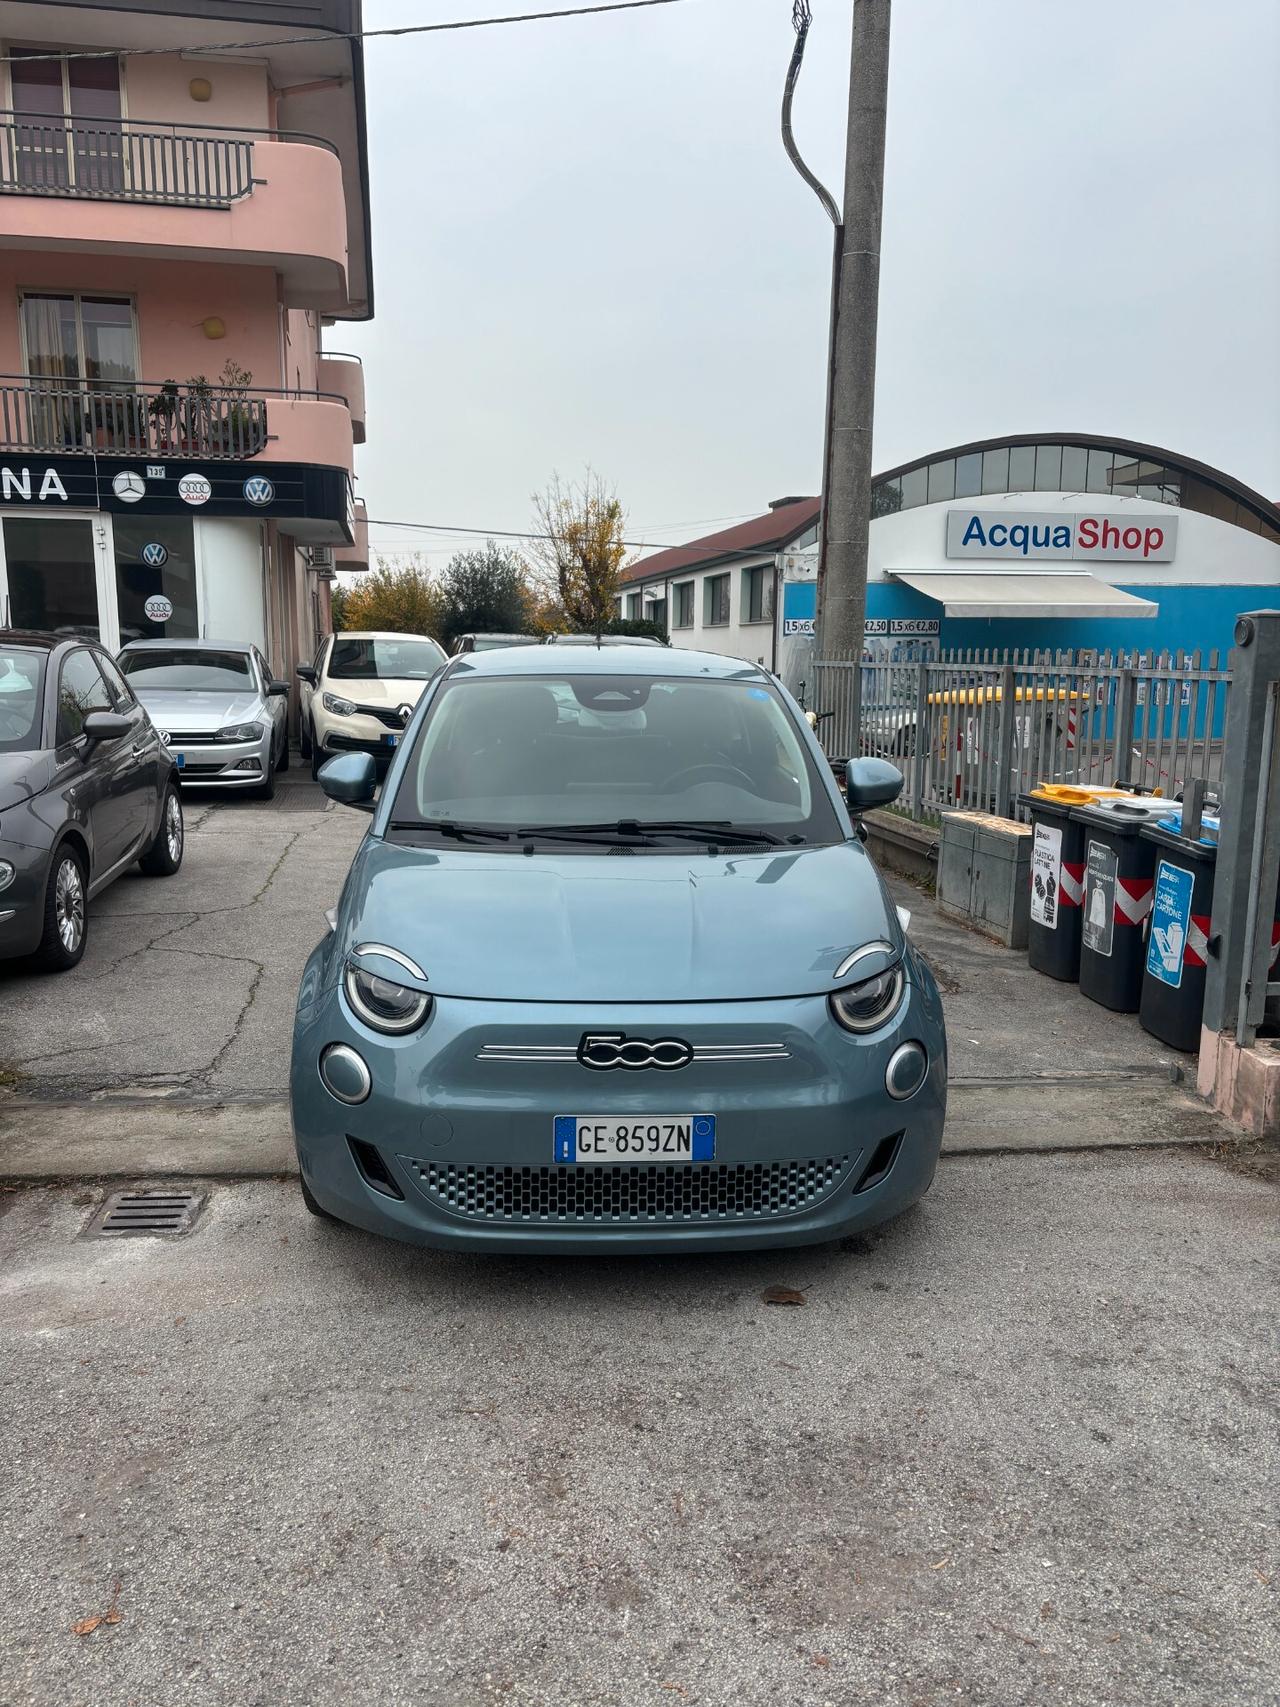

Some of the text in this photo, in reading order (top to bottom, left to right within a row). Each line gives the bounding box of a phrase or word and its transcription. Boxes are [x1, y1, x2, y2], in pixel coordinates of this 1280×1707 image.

[1, 467, 68, 500] NA
[150, 468, 164, 477] 139
[962, 516, 1164, 557] Acqua Shop
[916, 620, 938, 632] €2,80
[579, 1034, 691, 1068] 500
